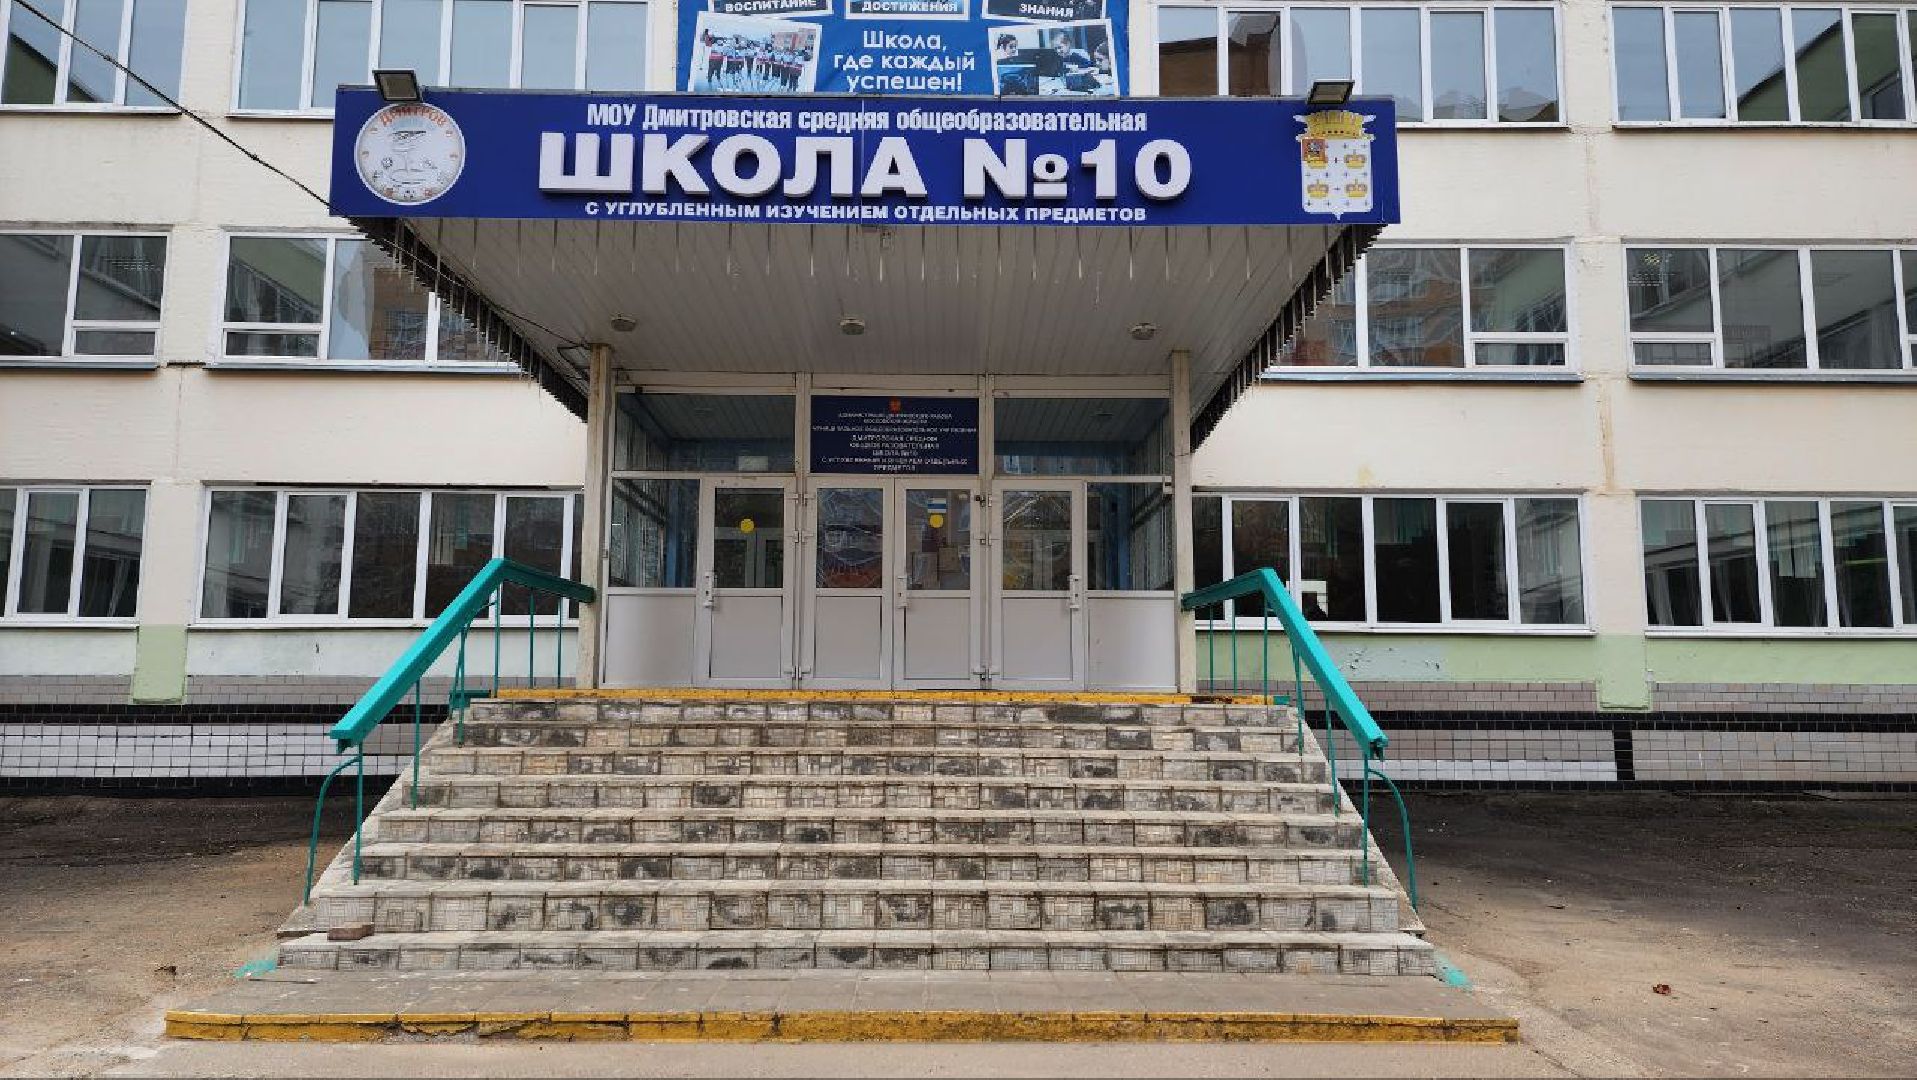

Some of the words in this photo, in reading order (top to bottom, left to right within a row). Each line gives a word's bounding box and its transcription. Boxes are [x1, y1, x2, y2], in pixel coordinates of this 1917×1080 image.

[725, 0, 817, 12] ВОСПИТАНИЕ
[861, 1, 958, 12] ДОСТИЖЕНИЯ
[1019, 3, 1074, 18] ЗНАНИЯ
[863, 30, 947, 51] Школа,
[833, 54, 873, 71] где
[881, 51, 975, 72] каждый
[847, 75, 962, 93] успешен!
[587, 103, 637, 126] МОУ
[642, 104, 792, 131] Дмитровская
[798, 108, 890, 134] средняя
[896, 108, 1148, 134] общеобразовательная
[538, 131, 929, 198] ШКОЛА
[585, 201, 600, 216] С
[605, 202, 761, 219] УГЛУБЛЕННЫМ
[766, 204, 889, 220] ИЗУЧЕНИЕМ
[894, 206, 1019, 223] ОТДЕЛЬНЫХ
[1024, 207, 1148, 224] ПРЕДМЕТОВ
